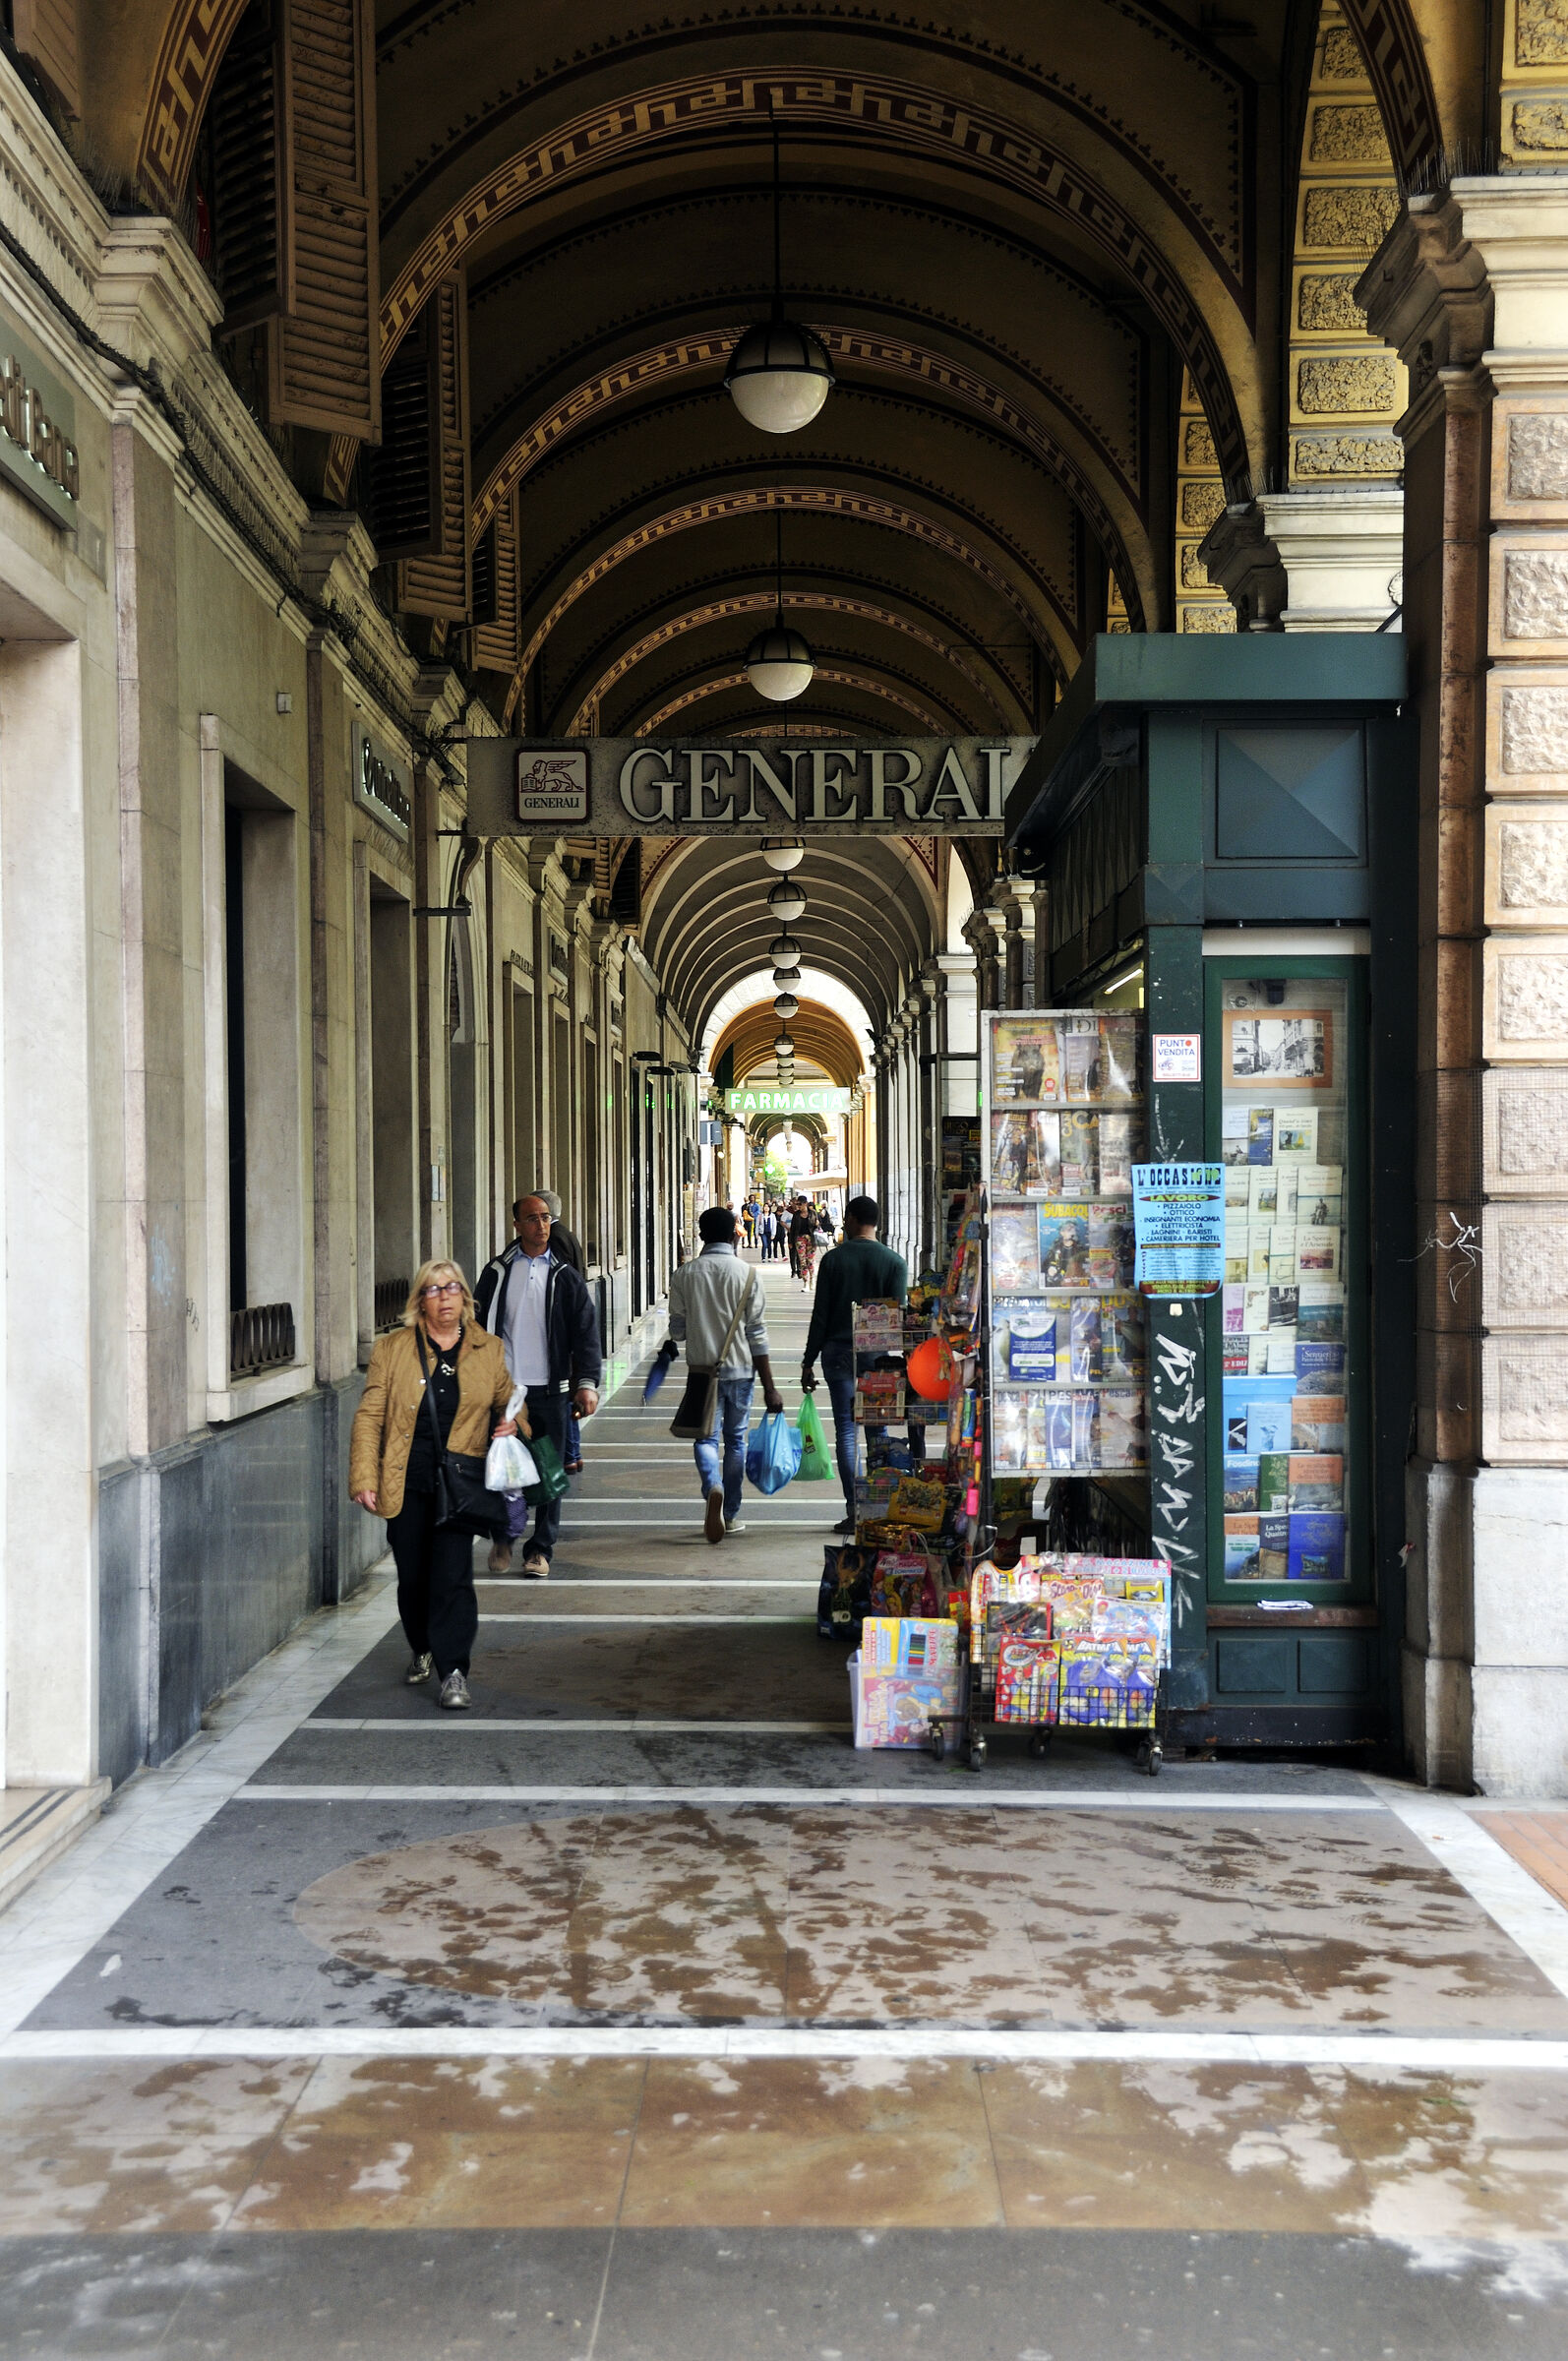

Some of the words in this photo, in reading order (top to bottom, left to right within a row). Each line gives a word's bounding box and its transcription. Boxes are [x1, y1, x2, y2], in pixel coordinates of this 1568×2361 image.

[620, 748, 1011, 821] GENERAL
[524, 798, 579, 808] GENERALI
[730, 1092, 844, 1110] FARMACIA
